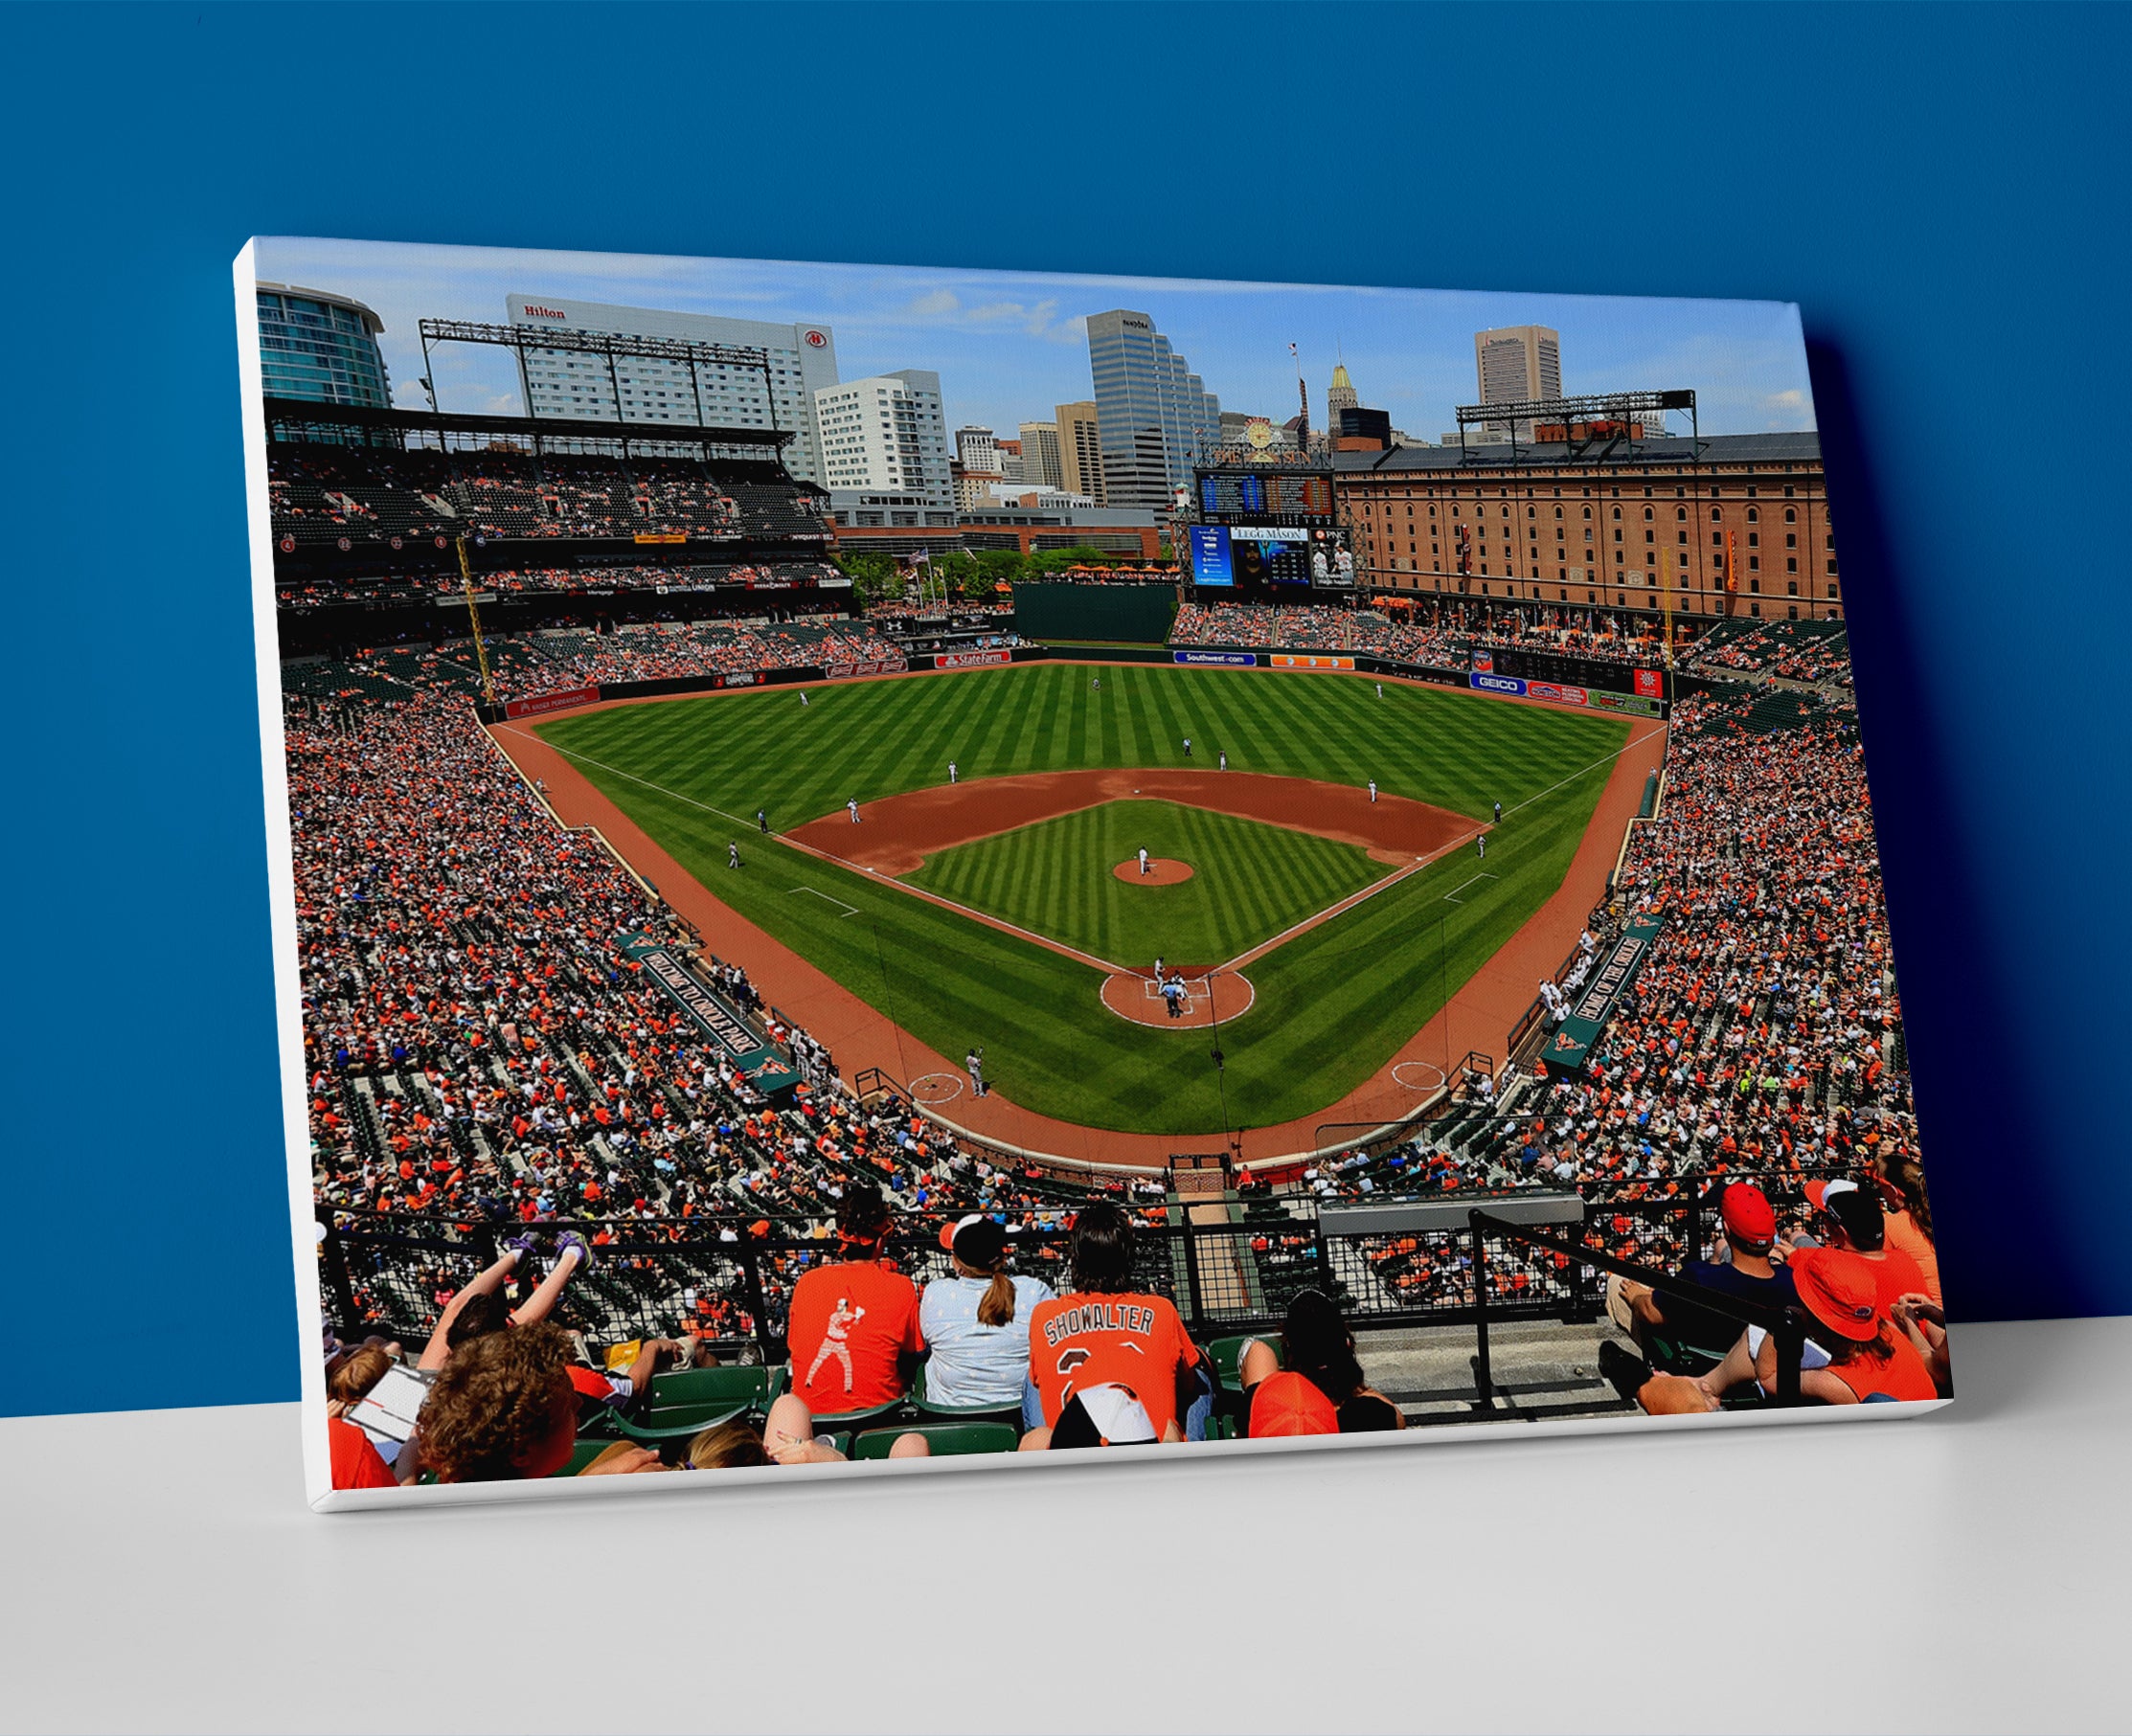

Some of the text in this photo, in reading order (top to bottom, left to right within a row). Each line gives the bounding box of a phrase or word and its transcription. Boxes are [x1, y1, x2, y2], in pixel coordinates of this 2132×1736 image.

[524, 305, 566, 319] Hilton
[1283, 449, 1310, 464] SUN
[1237, 529, 1302, 539] LEGG MASON
[1327, 530, 1347, 540] PNC
[692, 582, 715, 592] UNION
[1480, 677, 1518, 691] GEICO
[1578, 991, 1608, 1020] HOME
[1601, 963, 1626, 982] THE
[719, 1025, 759, 1053] PARK
[1043, 1303, 1155, 1347] SHOWALTER
